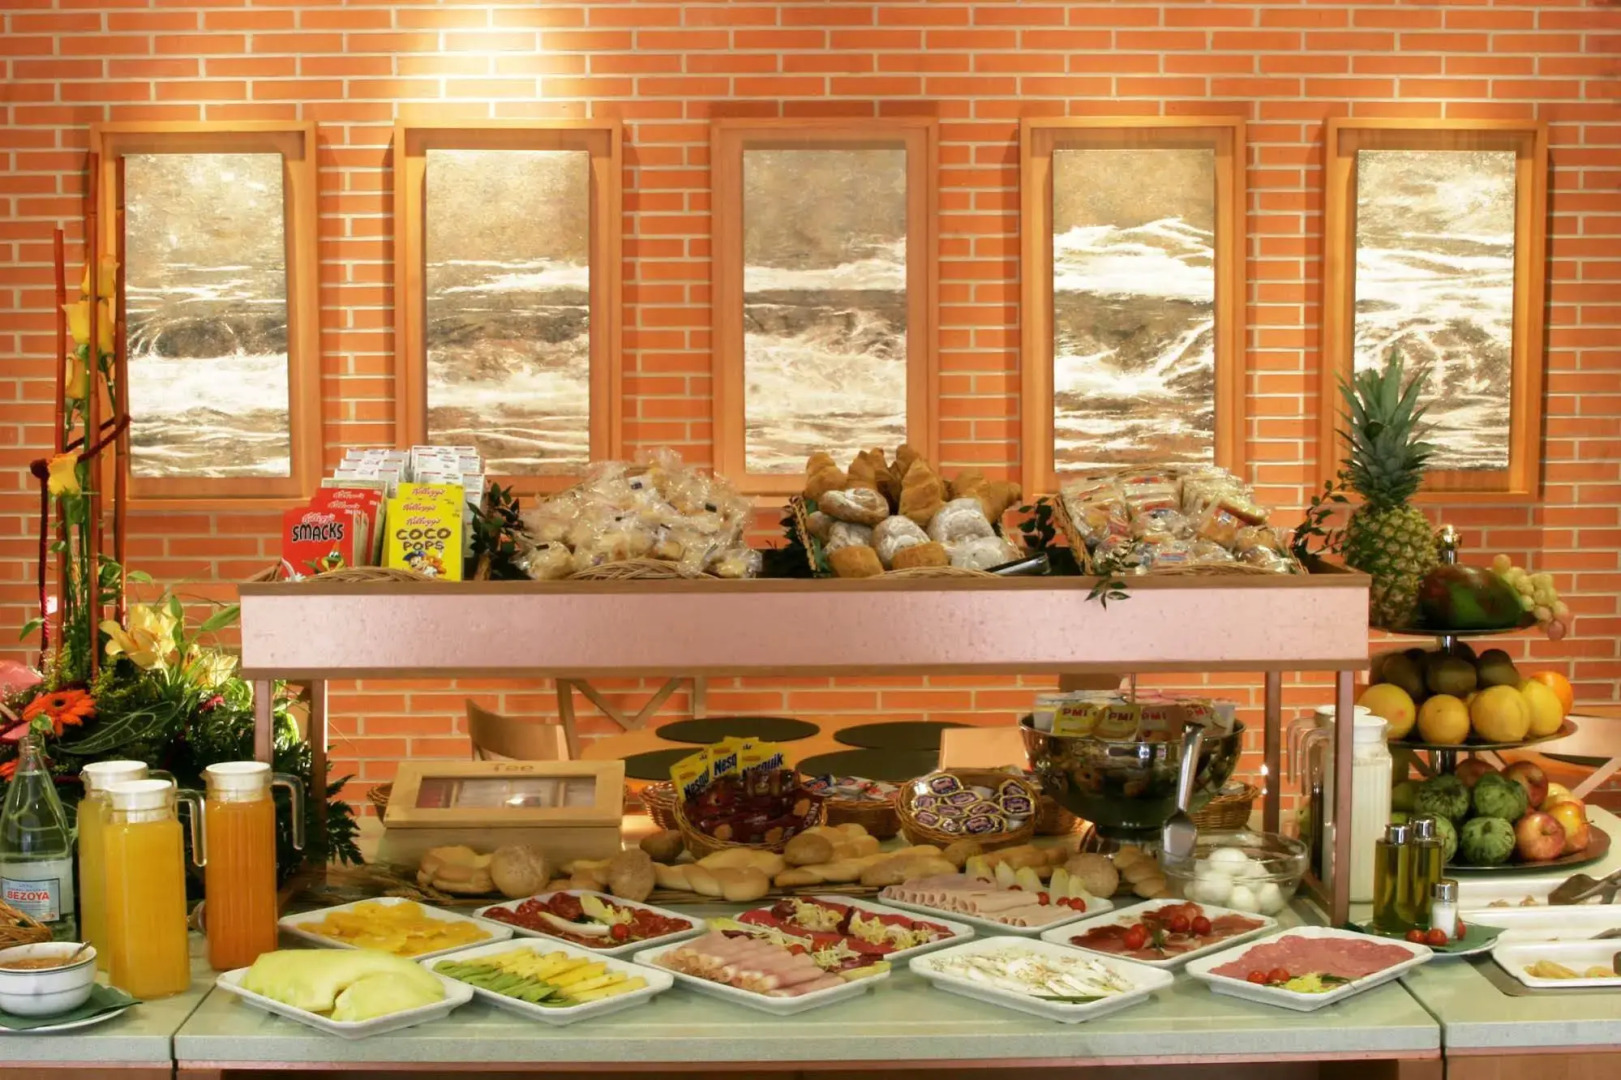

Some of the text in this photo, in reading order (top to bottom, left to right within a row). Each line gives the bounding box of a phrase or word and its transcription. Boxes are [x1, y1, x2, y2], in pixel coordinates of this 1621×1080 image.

[292, 522, 345, 543] SMACKS
[396, 527, 452, 541] COCO
[403, 541, 445, 552] POPS
[1062, 707, 1088, 717] PMI
[1108, 711, 1135, 721] PMI
[7, 891, 49, 901] BEZOYA
